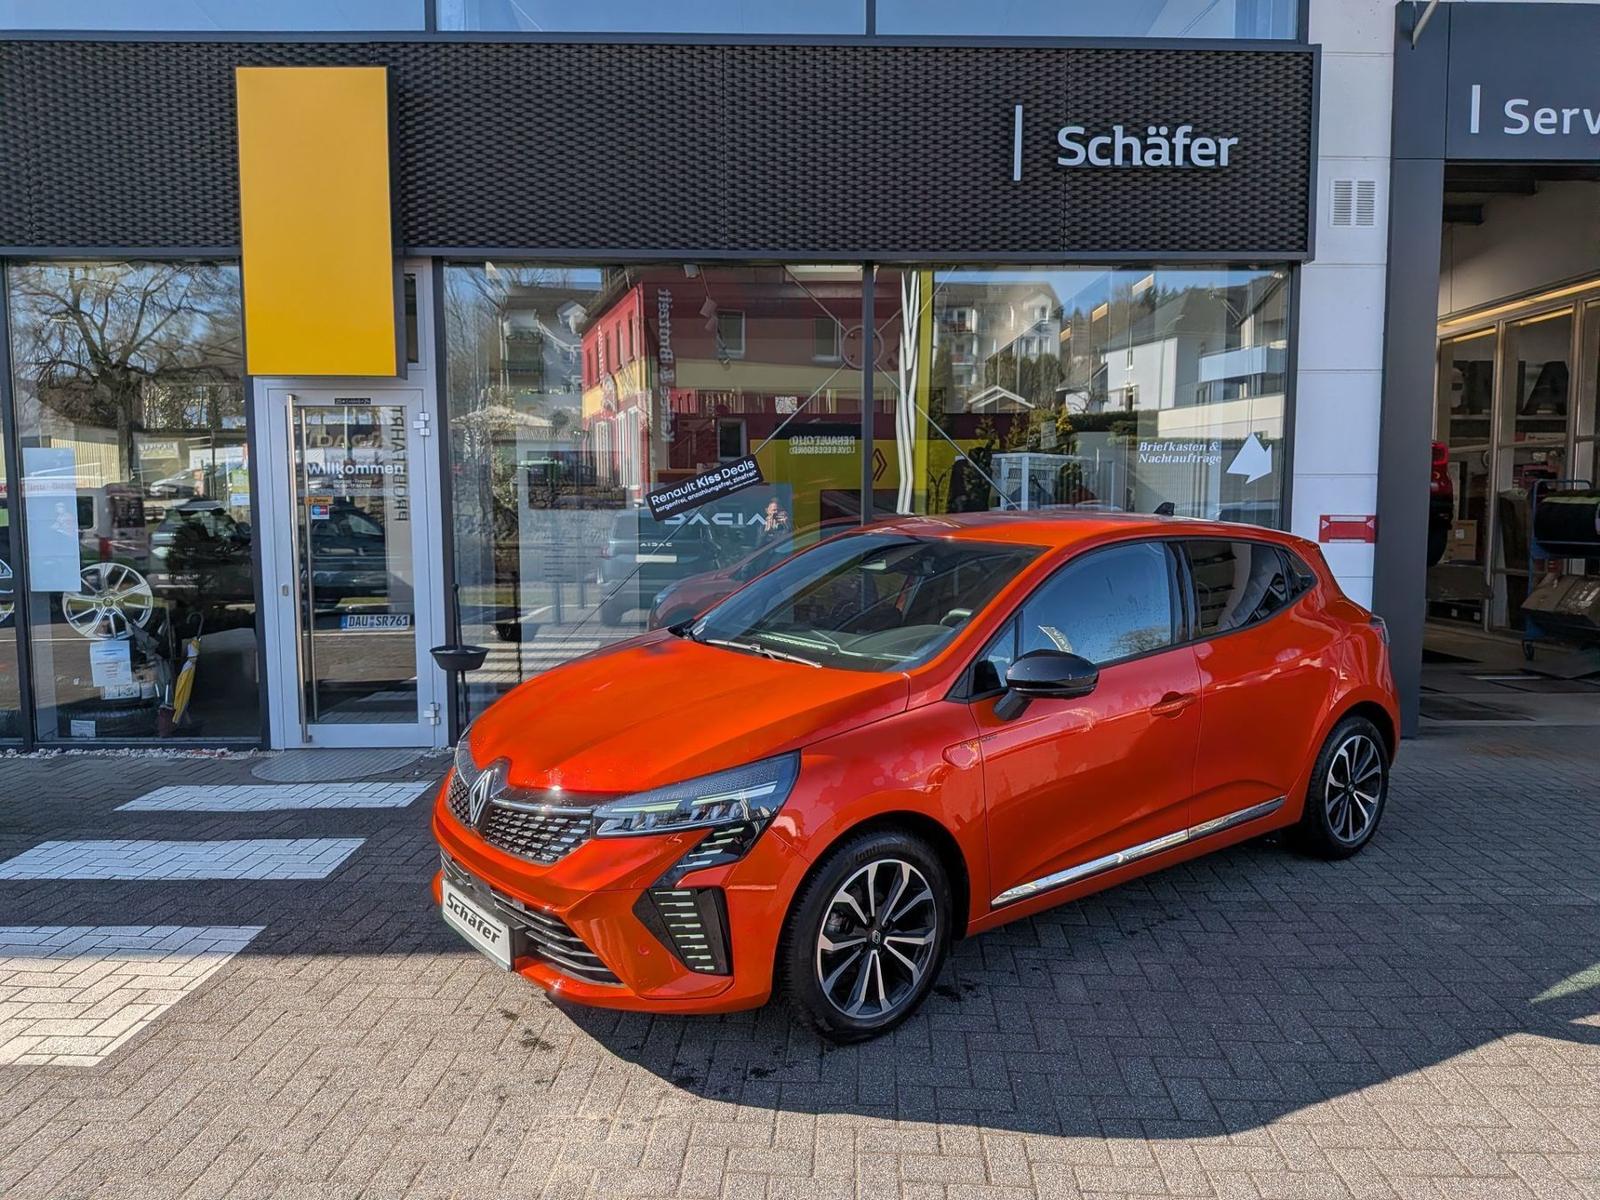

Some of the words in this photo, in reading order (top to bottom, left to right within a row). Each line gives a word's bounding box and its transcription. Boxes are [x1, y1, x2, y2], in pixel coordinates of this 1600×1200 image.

[1503, 98, 1600, 135] Serv
[1057, 125, 1239, 167] Schäfer
[1139, 442, 1206, 452] Briefkasten
[1209, 441, 1219, 452] &
[651, 482, 697, 506] Renault
[696, 473, 721, 488] Kiss
[721, 460, 755, 479] Deals
[664, 512, 768, 526] DACIA
[348, 615, 369, 627] DAU
[446, 892, 502, 944] Schäfer
